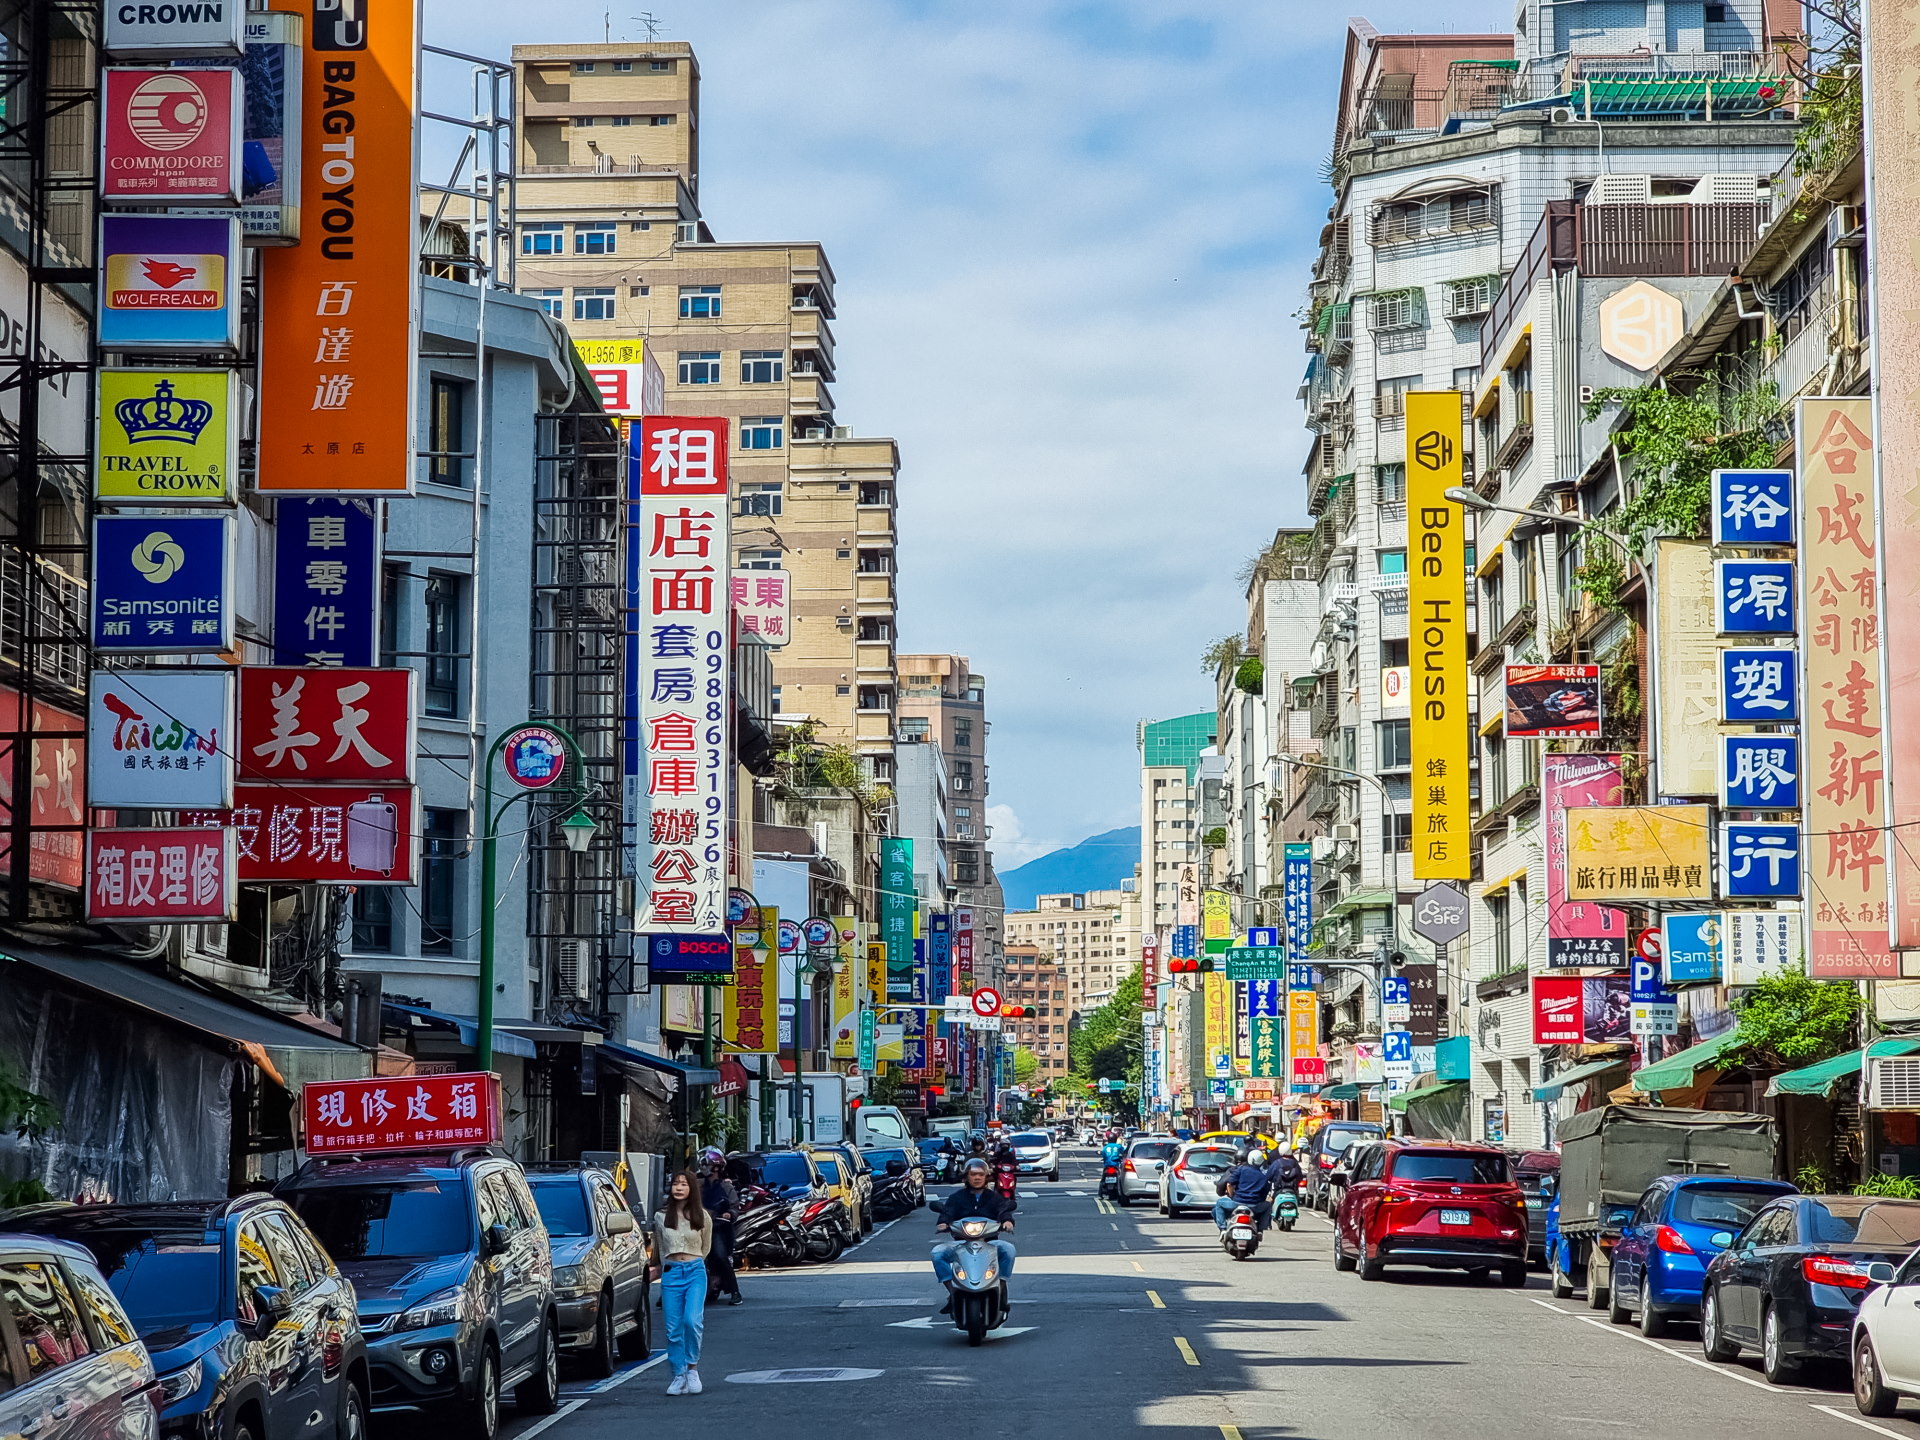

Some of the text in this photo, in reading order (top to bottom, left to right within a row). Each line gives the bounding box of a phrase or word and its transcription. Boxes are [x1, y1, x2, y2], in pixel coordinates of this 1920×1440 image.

[118, 4, 222, 24] CROWN
[111, 156, 224, 169] COMMODORE
[321, 61, 355, 260] BAGTOYOU
[152, 169, 185, 177] Japan
[117, 178, 158, 188] 戰車系列
[116, 294, 214, 305] WOLFREALM
[311, 280, 358, 411] 百達遊
[302, 442, 365, 455] 太原店
[103, 456, 188, 471] TRAVEL
[650, 428, 718, 487] 租
[138, 473, 221, 490] CROWN
[1809, 409, 1875, 559] 合成
[103, 596, 219, 615] Samsonite
[1420, 507, 1452, 722] Bee House
[103, 619, 218, 635] 新秀麗
[252, 676, 393, 770] 美天
[123, 755, 206, 770] 國民旅遊卡
[1426, 757, 1448, 861] 蜂巢旅店
[96, 843, 220, 907] 箱皮理修
[1576, 865, 1702, 889] 旅行用品專賣
[889, 849, 905, 932] 雀客快捷
[1419, 910, 1461, 925] Cafe
[679, 942, 728, 953] BOSCH
[960, 936, 969, 970] 加耐力
[1562, 940, 1613, 951] 丁山五金
[1838, 939, 1867, 951] TEL
[1232, 950, 1277, 959] 長安西路
[1556, 953, 1620, 965] 特約經銷商
[1817, 954, 1891, 968] 25583976
[1635, 962, 1654, 990] P
[1385, 980, 1396, 997] P
[1386, 1035, 1398, 1051] P
[317, 1082, 478, 1127] 現修皮箱
